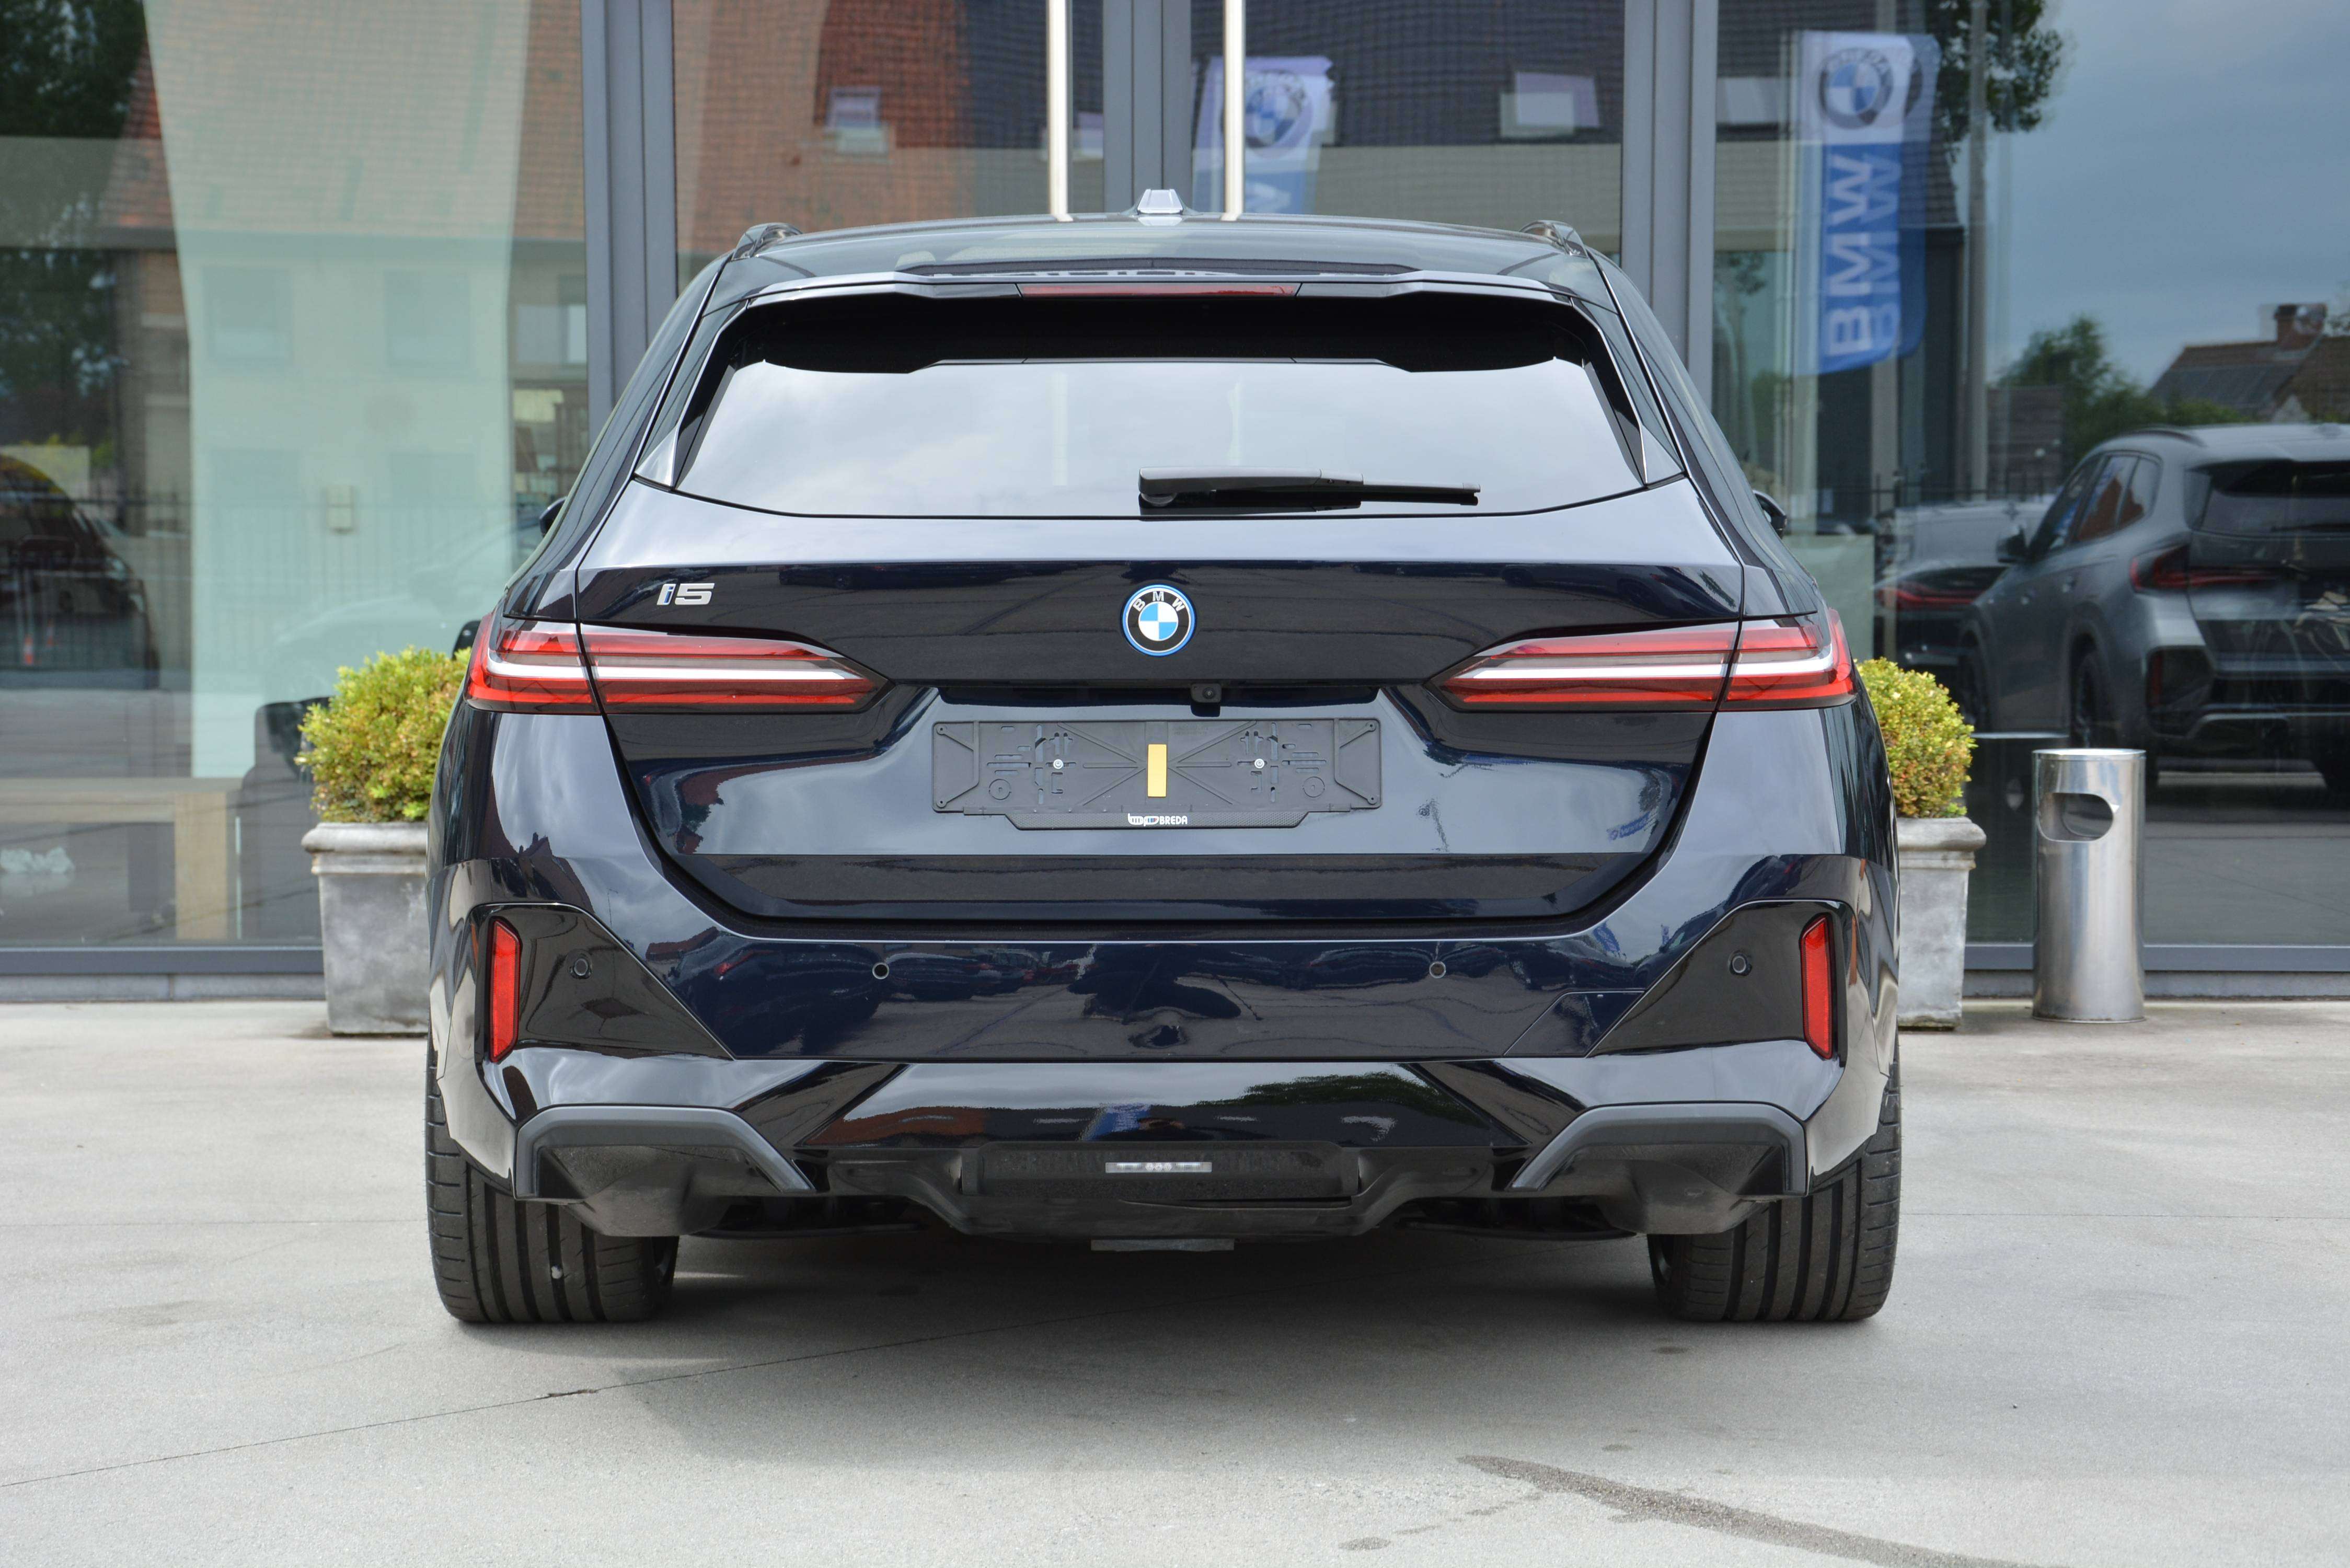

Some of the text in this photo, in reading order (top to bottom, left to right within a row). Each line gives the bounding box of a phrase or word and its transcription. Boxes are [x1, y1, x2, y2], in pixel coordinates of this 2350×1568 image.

[1825, 154, 1873, 356] BMW
[656, 583, 715, 606] i5
[1132, 591, 1185, 612] BMW
[1159, 815, 1188, 825] BREDA
